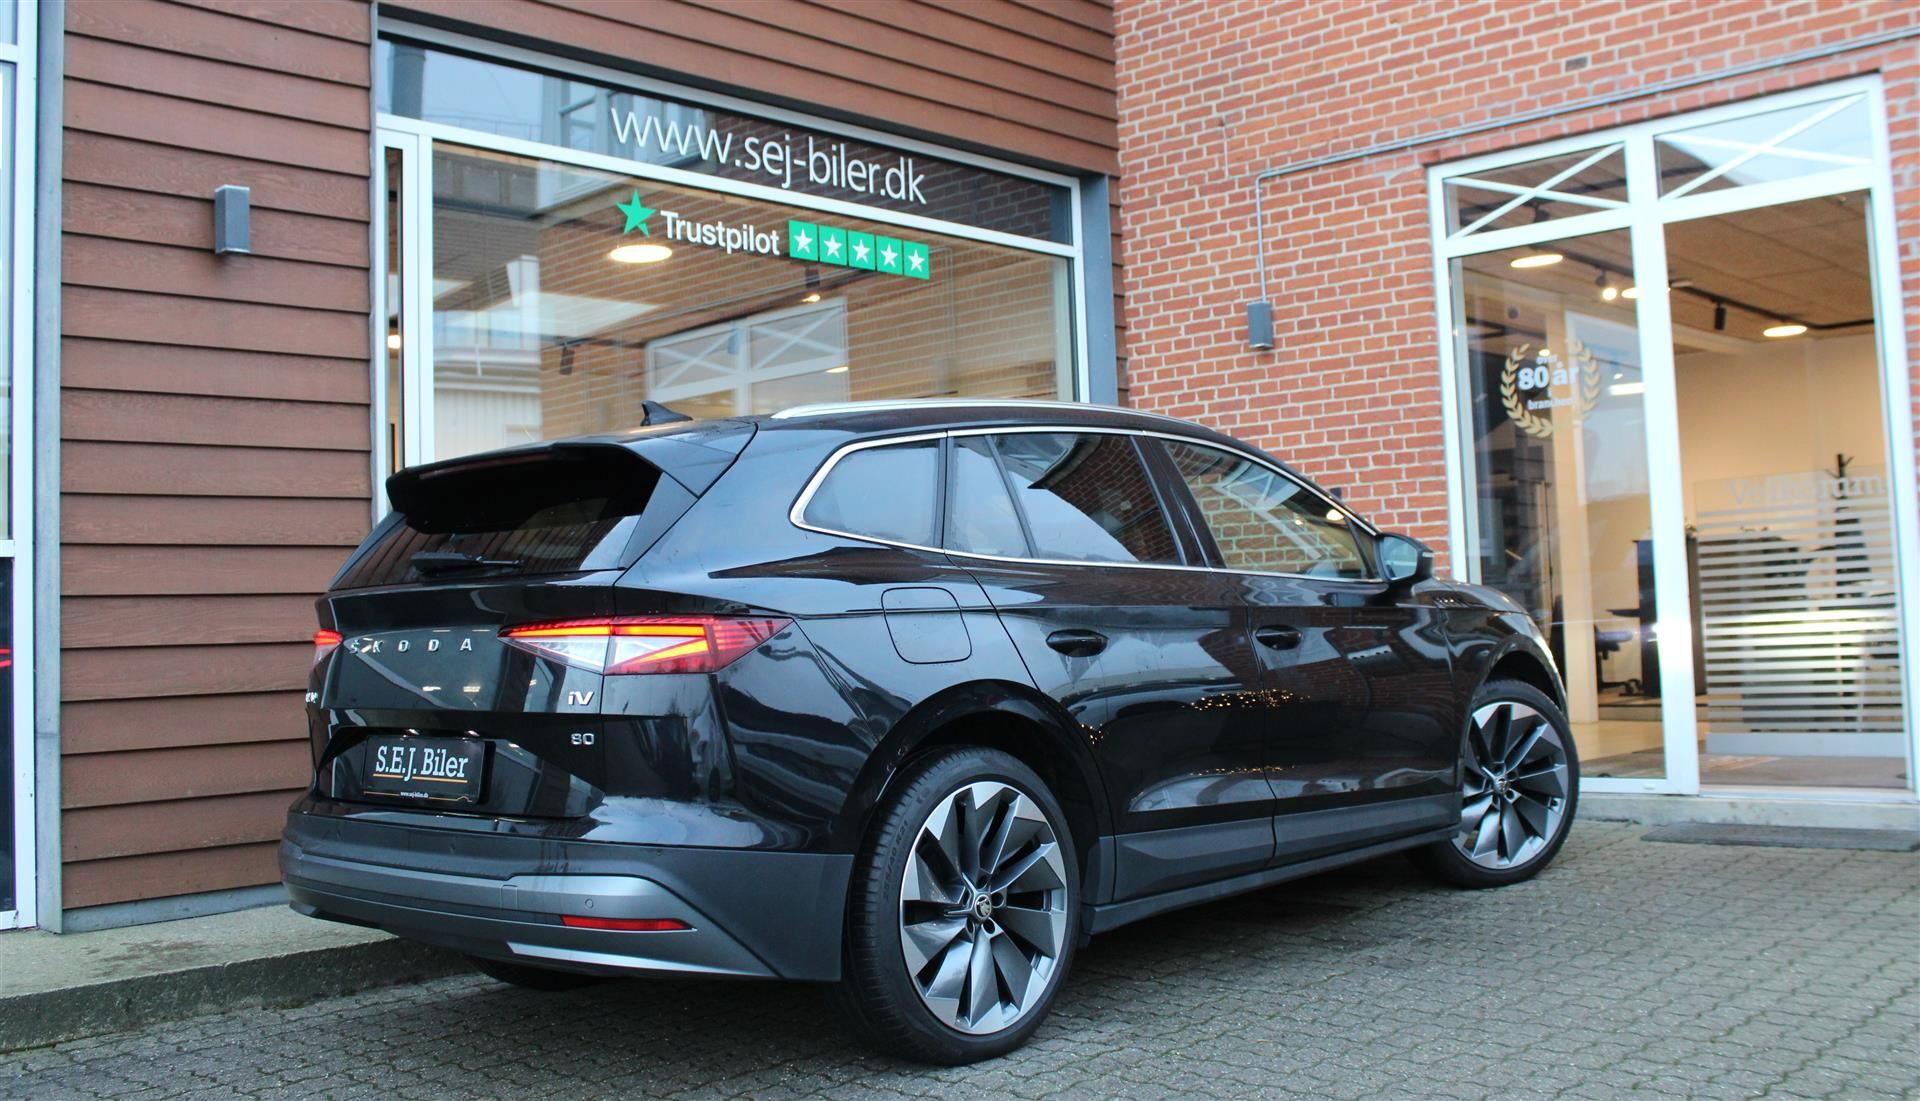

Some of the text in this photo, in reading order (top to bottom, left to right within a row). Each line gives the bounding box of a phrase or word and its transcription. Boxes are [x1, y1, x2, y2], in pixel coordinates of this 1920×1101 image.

[611, 107, 927, 204] www.sej-biler.dk
[661, 210, 780, 256] Trustpilot
[1517, 365, 1549, 391] 80
[570, 732, 595, 746] 80
[375, 744, 469, 782] S.E.J. Biler
